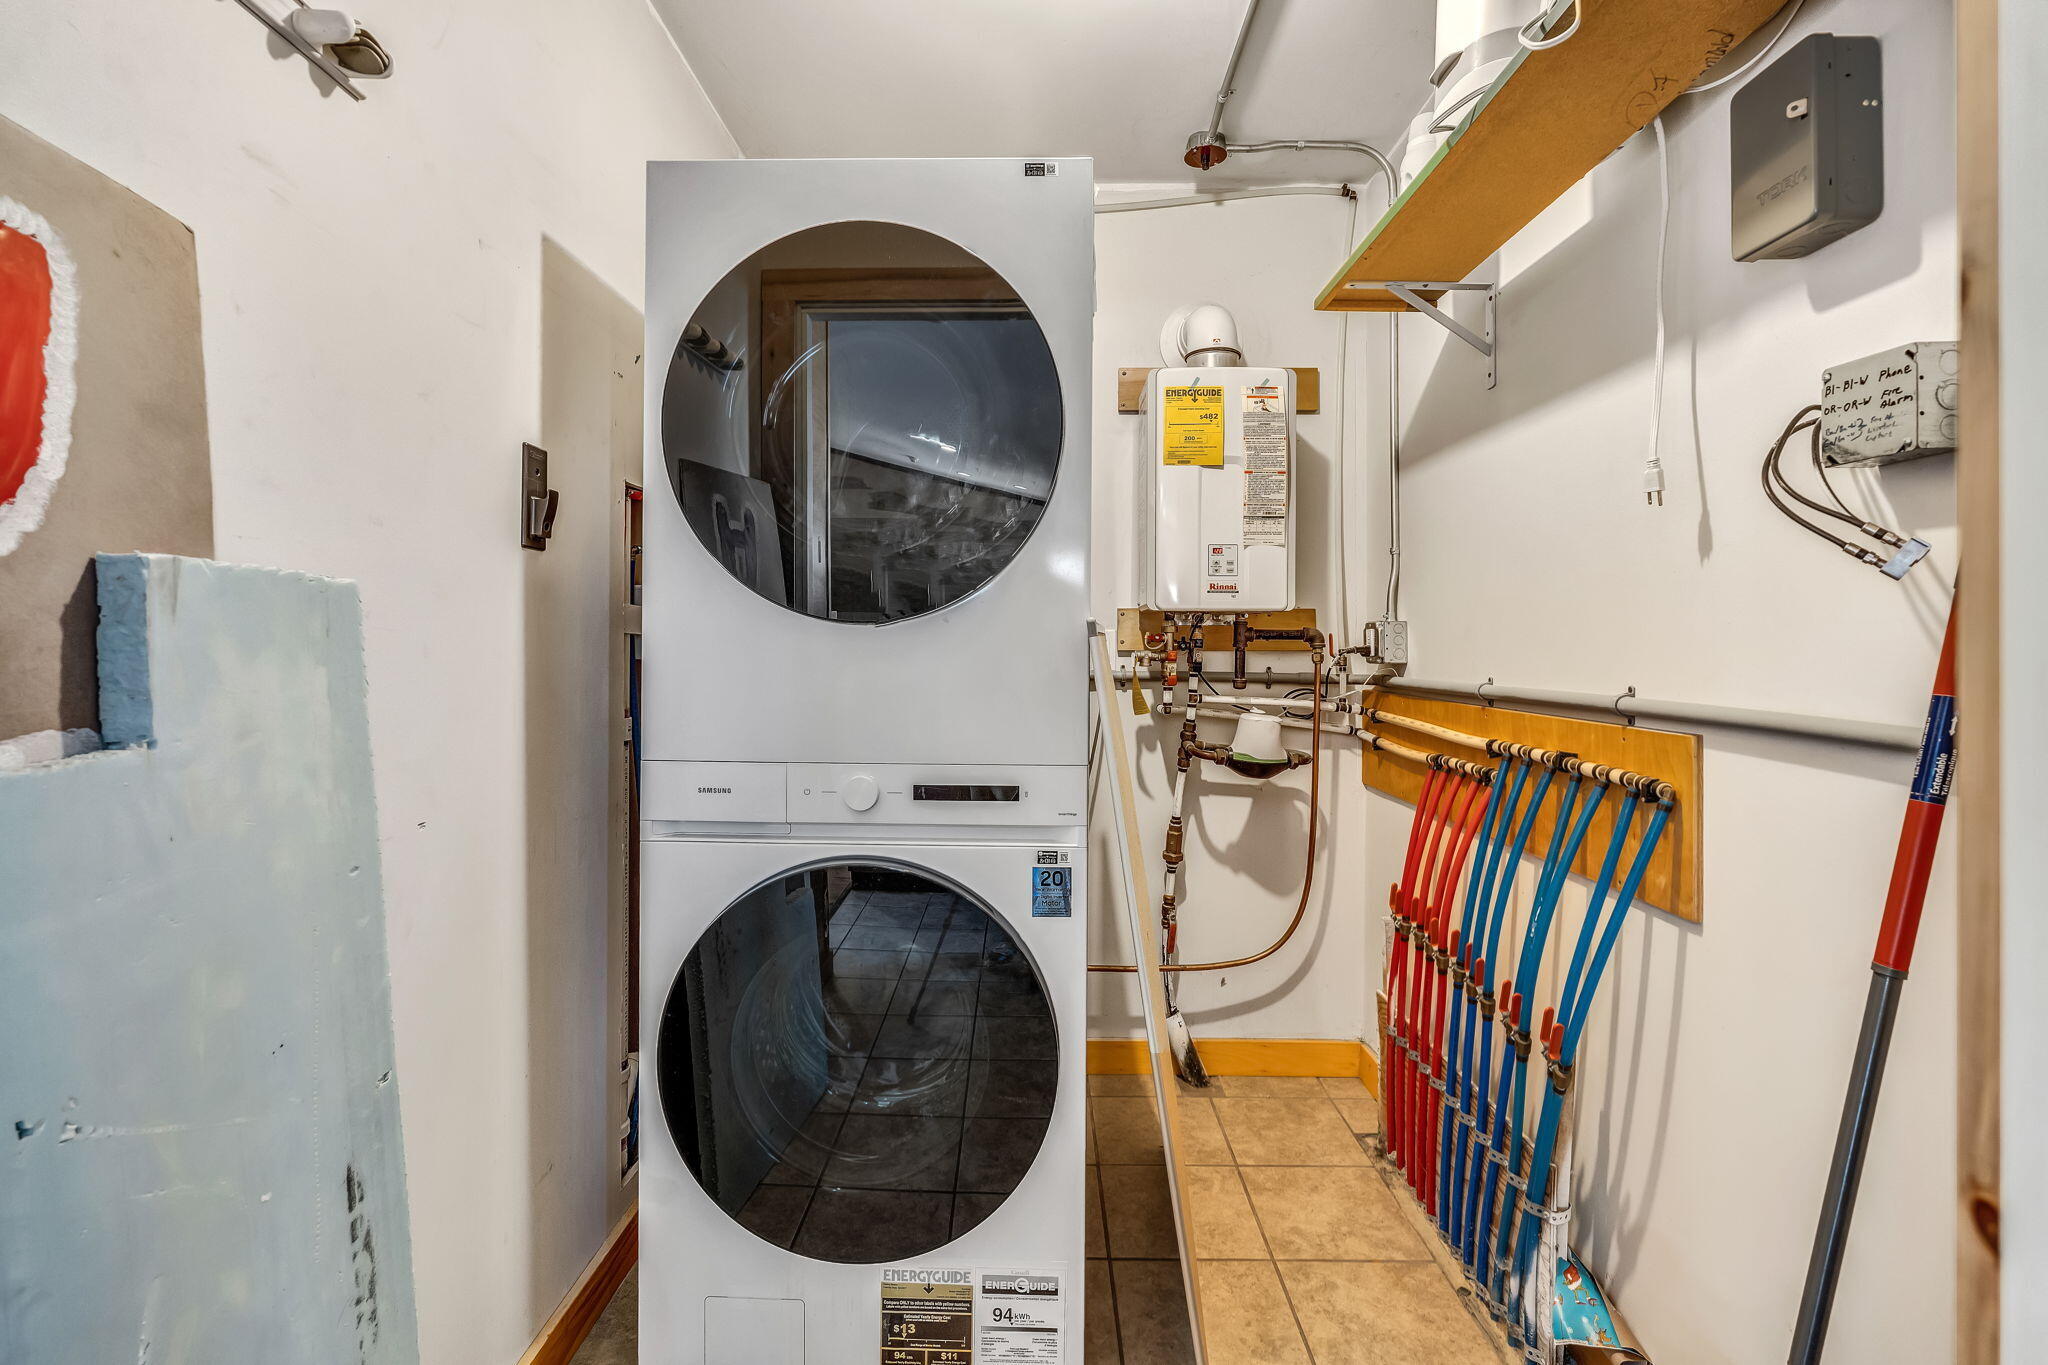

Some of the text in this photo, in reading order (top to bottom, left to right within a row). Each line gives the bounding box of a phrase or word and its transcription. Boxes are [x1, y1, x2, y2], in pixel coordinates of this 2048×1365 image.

[1878, 365, 1912, 382] Phone
[1165, 389, 1222, 398] ENERGYGUIDE
[1930, 753, 1948, 796] Extendable
[1040, 870, 1064, 887] 20
[883, 1269, 972, 1283] ENERGYGUIDE
[992, 1307, 1013, 1322] 94
[893, 1323, 916, 1335] $13
[894, 1351, 906, 1359] 94
[940, 1352, 958, 1360] $11
